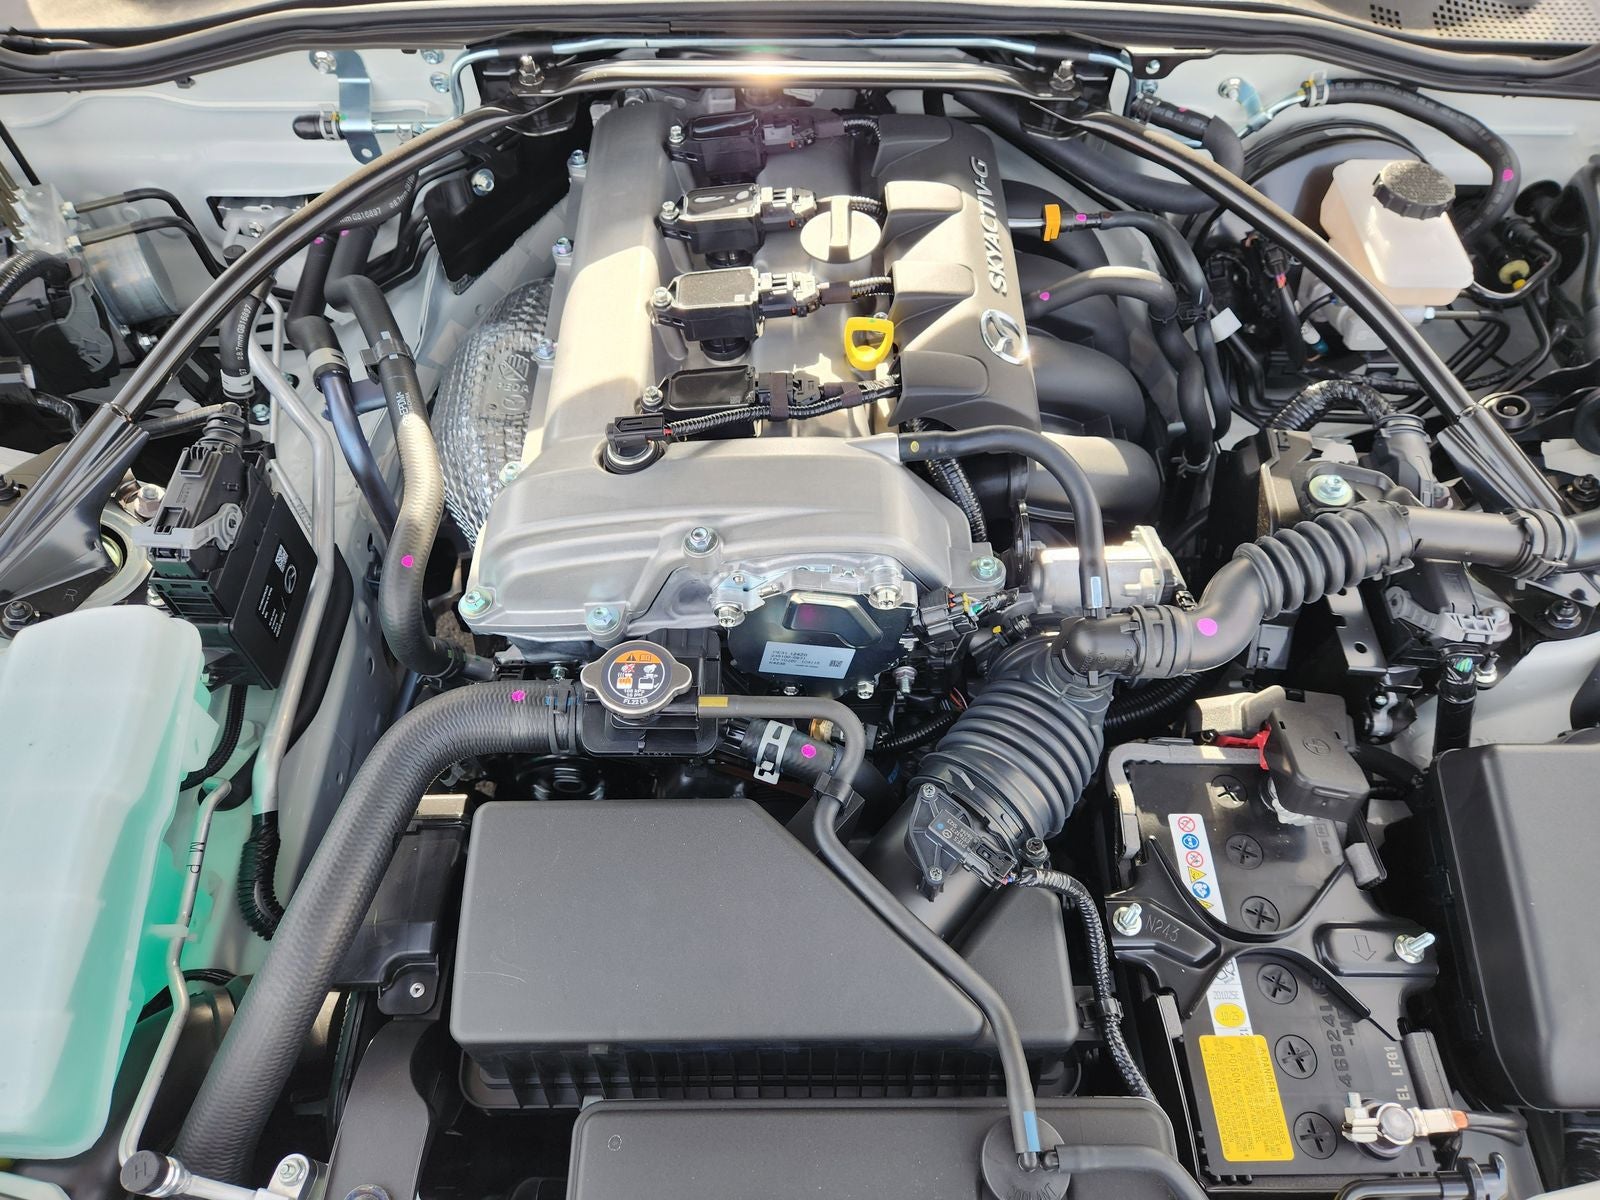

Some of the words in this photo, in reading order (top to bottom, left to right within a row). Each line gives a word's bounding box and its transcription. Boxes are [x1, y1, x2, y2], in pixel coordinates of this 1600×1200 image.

[971, 156, 1007, 297] SKYACTIV-G
[1146, 914, 1180, 942] N243
[1226, 1053, 1242, 1083] POISON
[1259, 1056, 1276, 1092] DANGER
[1396, 1085, 1410, 1101] EL
